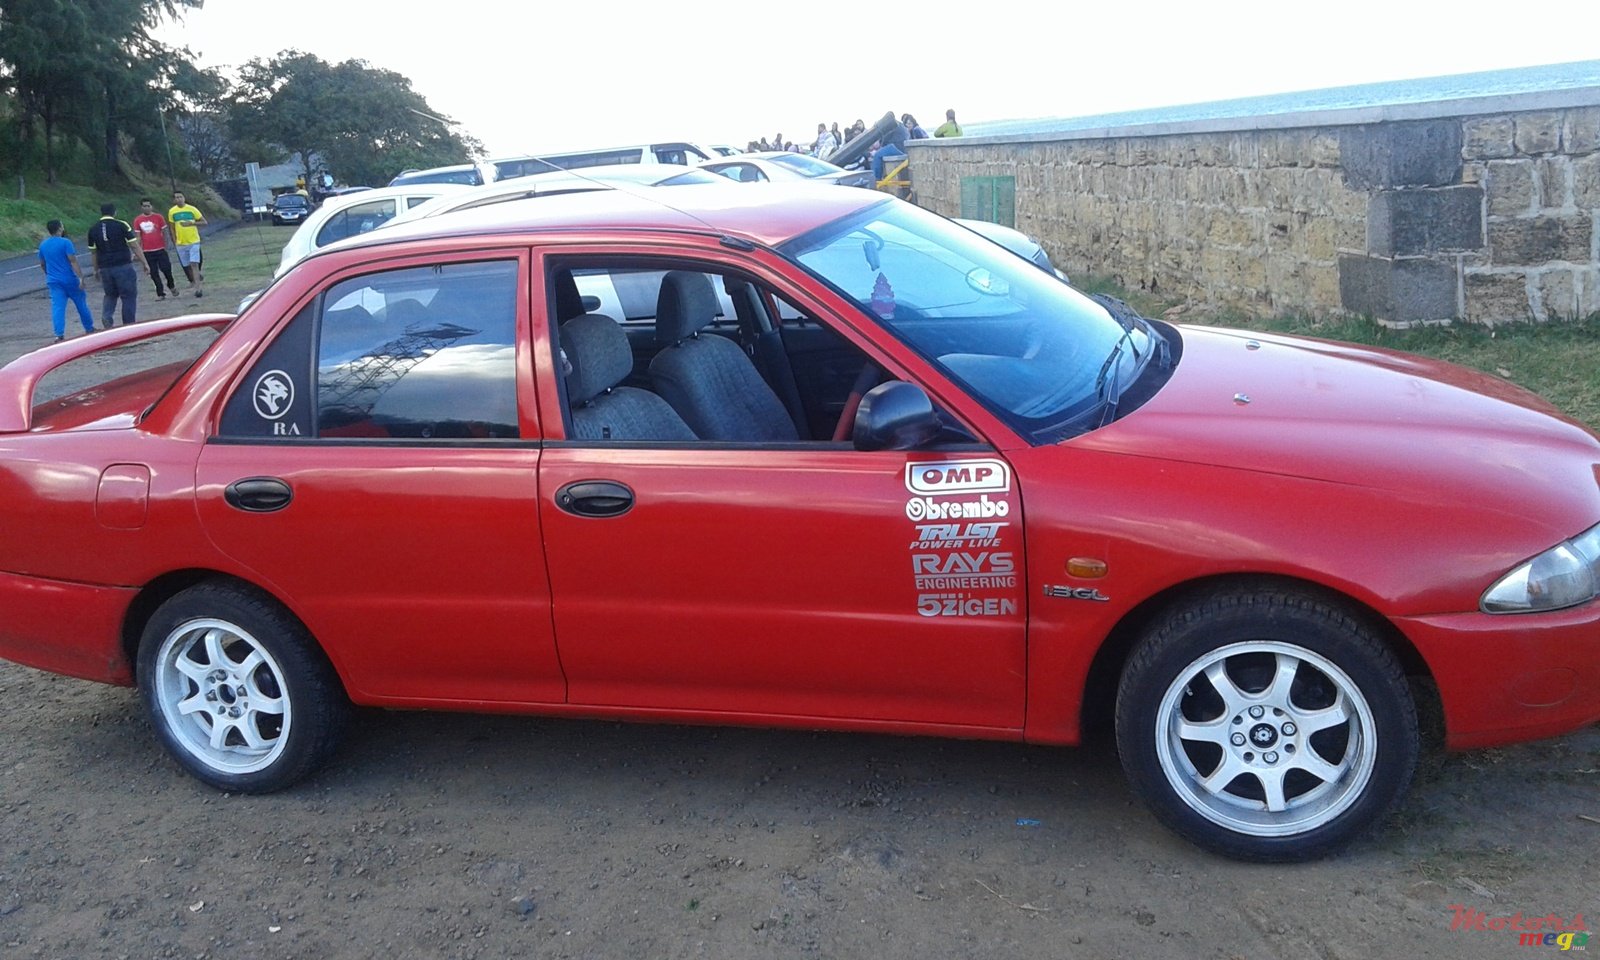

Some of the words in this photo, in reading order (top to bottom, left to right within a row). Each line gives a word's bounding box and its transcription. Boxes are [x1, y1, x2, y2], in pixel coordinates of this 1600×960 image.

[274, 422, 300, 435] RA
[922, 467, 993, 485] OMP
[926, 495, 1010, 520] brembo
[915, 522, 1010, 541] TRUST
[909, 540, 963, 550] POWER
[968, 538, 1002, 548] LIVE
[912, 552, 1015, 574] RAYS
[915, 577, 1017, 590] ENGINEERING
